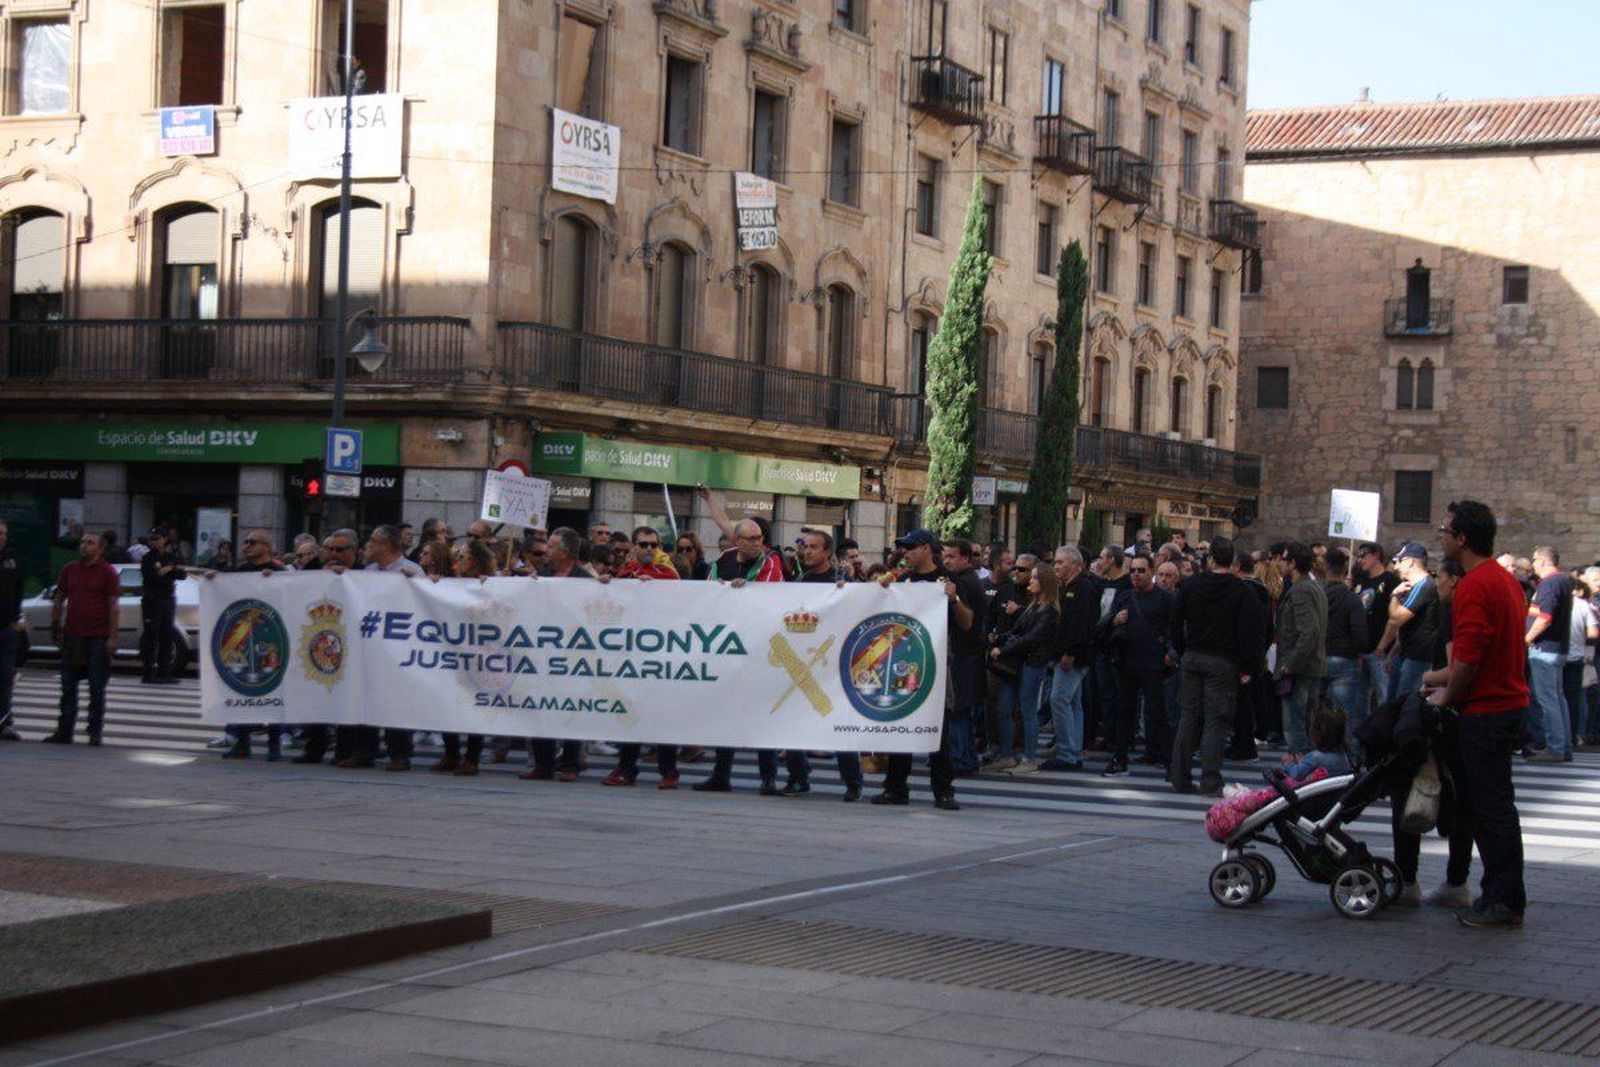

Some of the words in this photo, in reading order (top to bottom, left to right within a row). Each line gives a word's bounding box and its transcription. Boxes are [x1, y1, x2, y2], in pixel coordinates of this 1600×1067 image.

[560, 120, 611, 155] OYRSA
[98, 430, 146, 447] Espacio
[148, 430, 164, 445] de
[166, 430, 205, 445] Salud
[209, 430, 258, 446] DKV
[333, 432, 356, 467] P
[543, 444, 575, 456] DKV
[619, 450, 642, 466] Salud
[643, 452, 672, 468] DKV
[364, 476, 396, 488] DKV
[815, 470, 838, 483] DKV
[573, 488, 591, 497] DKV
[360, 610, 748, 656] #EQUIPARACIONYA
[399, 649, 537, 675] JUSTICIA
[548, 656, 719, 682] SALARIAL
[475, 692, 628, 715] SALAMANCA
[833, 724, 939, 734] WWW.JUSAPOL.ORG
